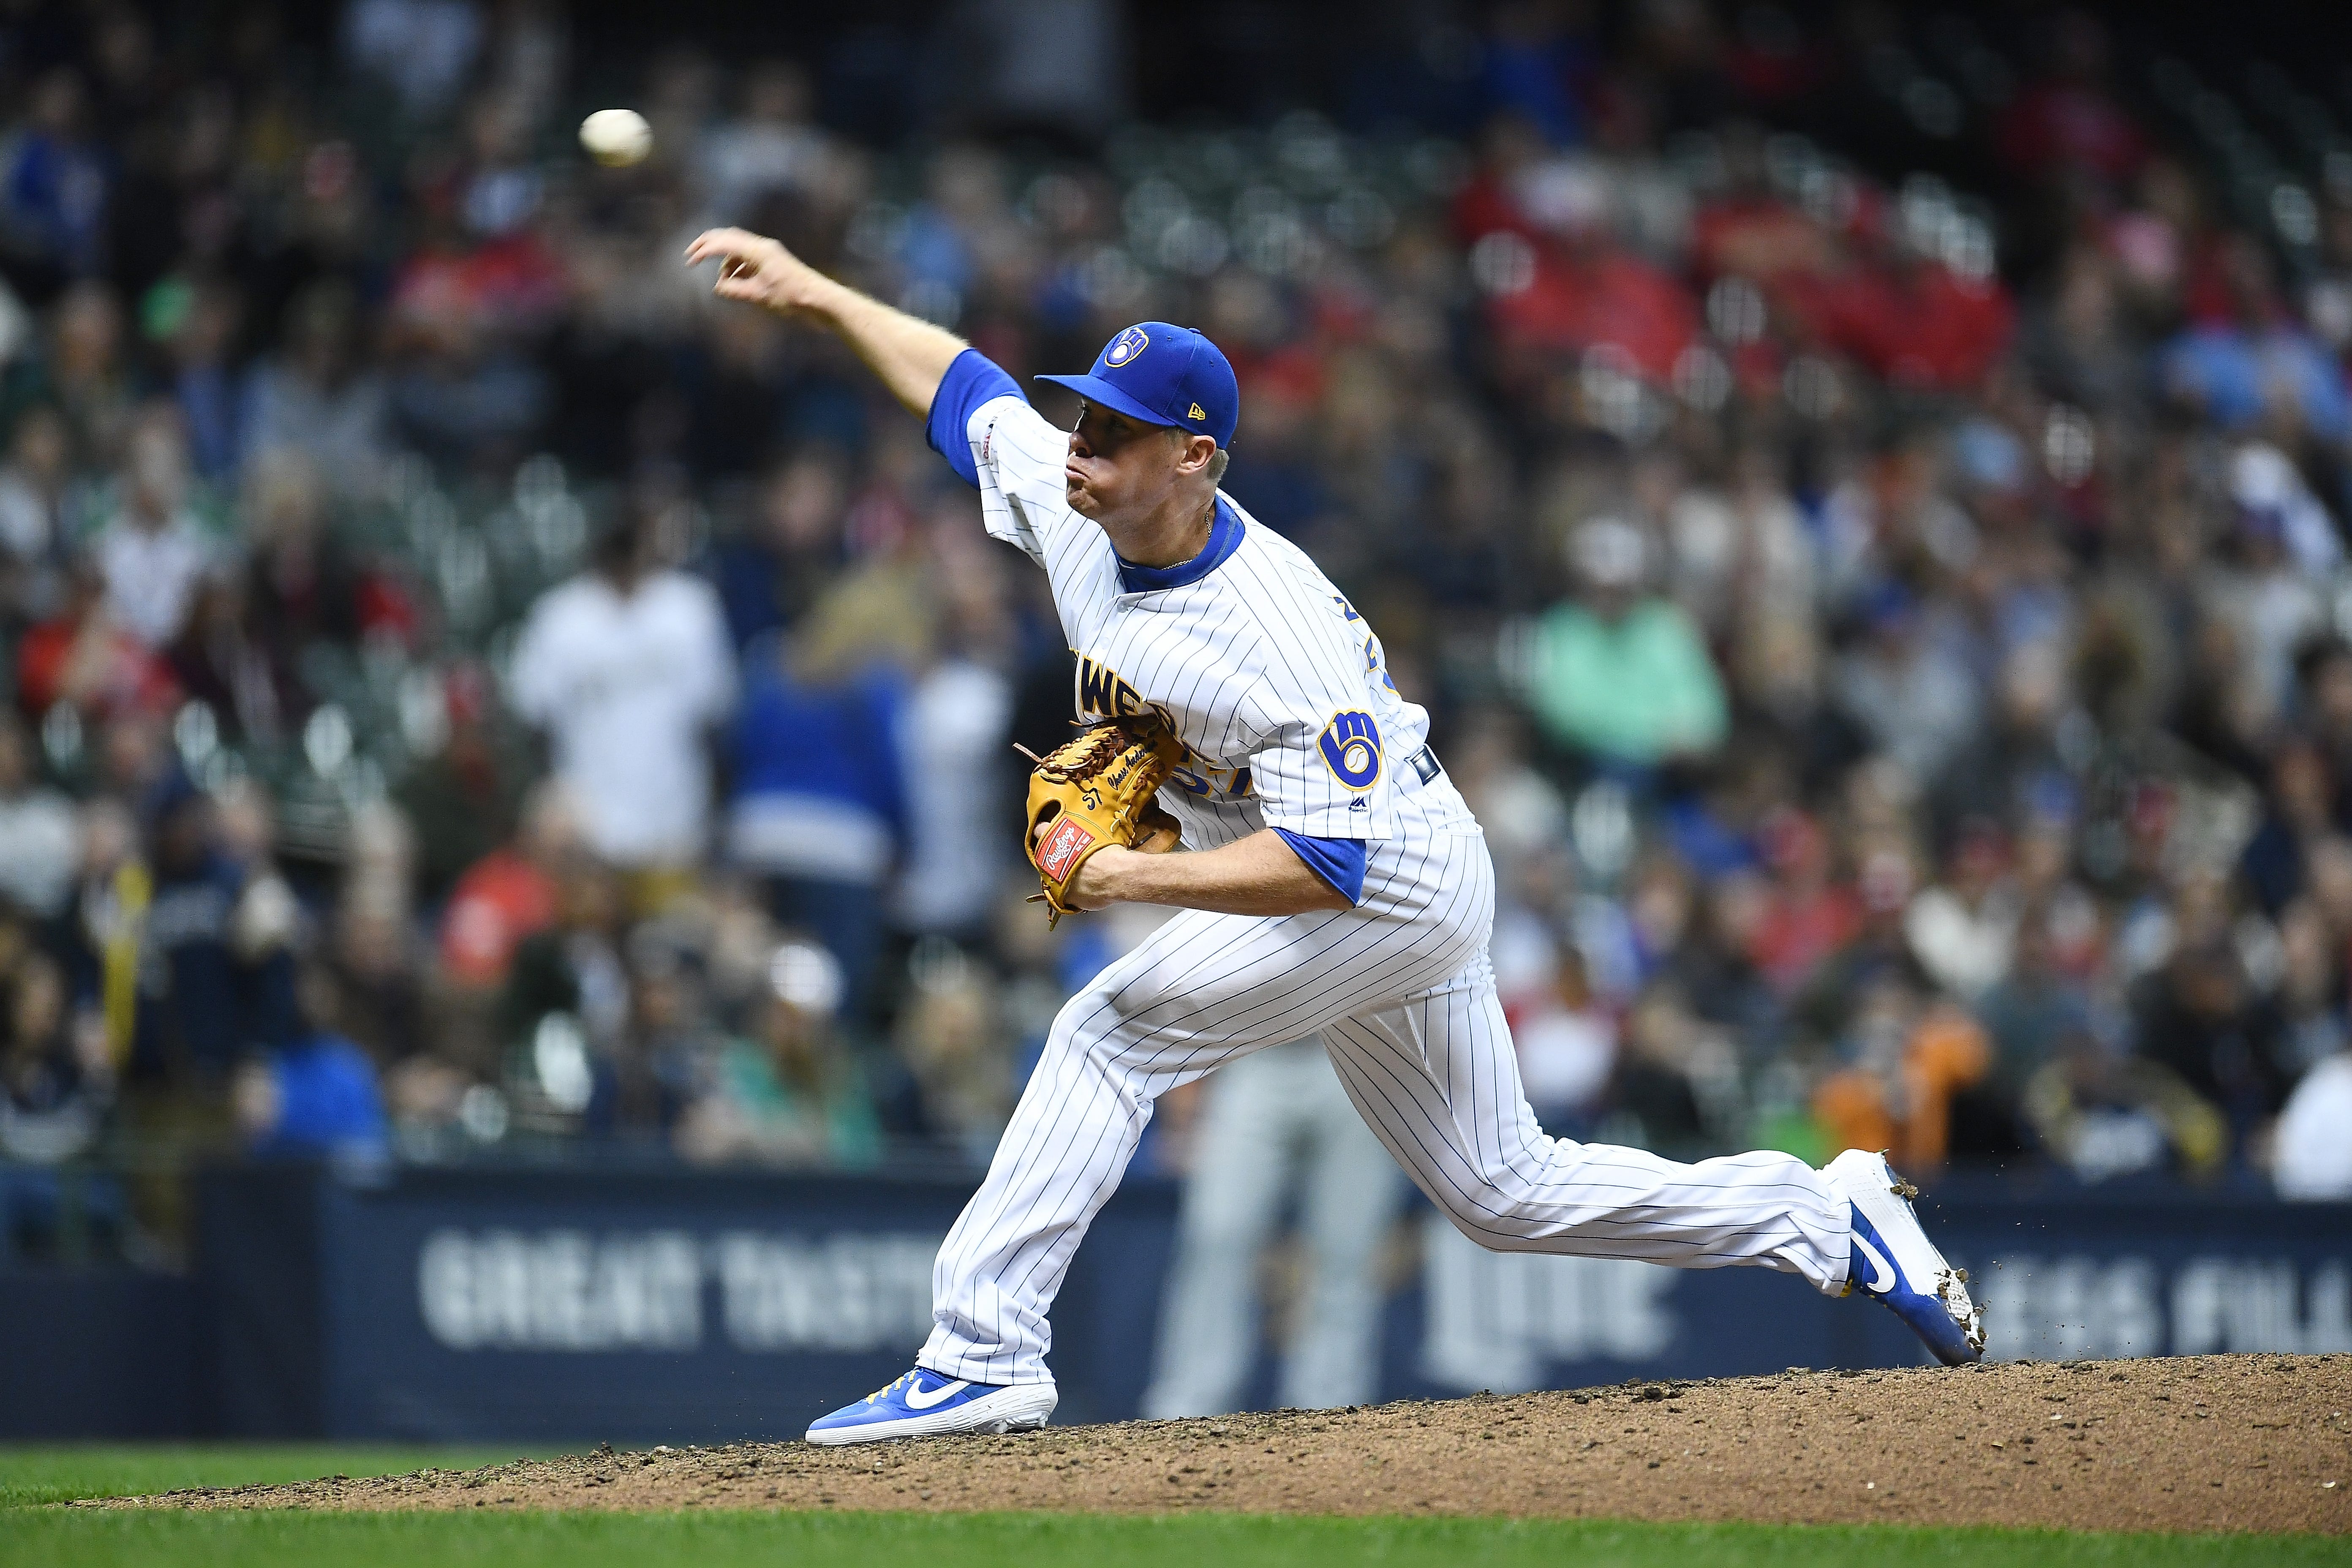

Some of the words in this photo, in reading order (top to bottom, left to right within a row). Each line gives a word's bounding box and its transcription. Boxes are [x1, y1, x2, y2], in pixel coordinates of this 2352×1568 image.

[1107, 766, 1129, 791] Chase
[1082, 787, 1102, 811] 57
[1046, 826, 1075, 870] Rawlings
[420, 1231, 700, 1349] GREAT
